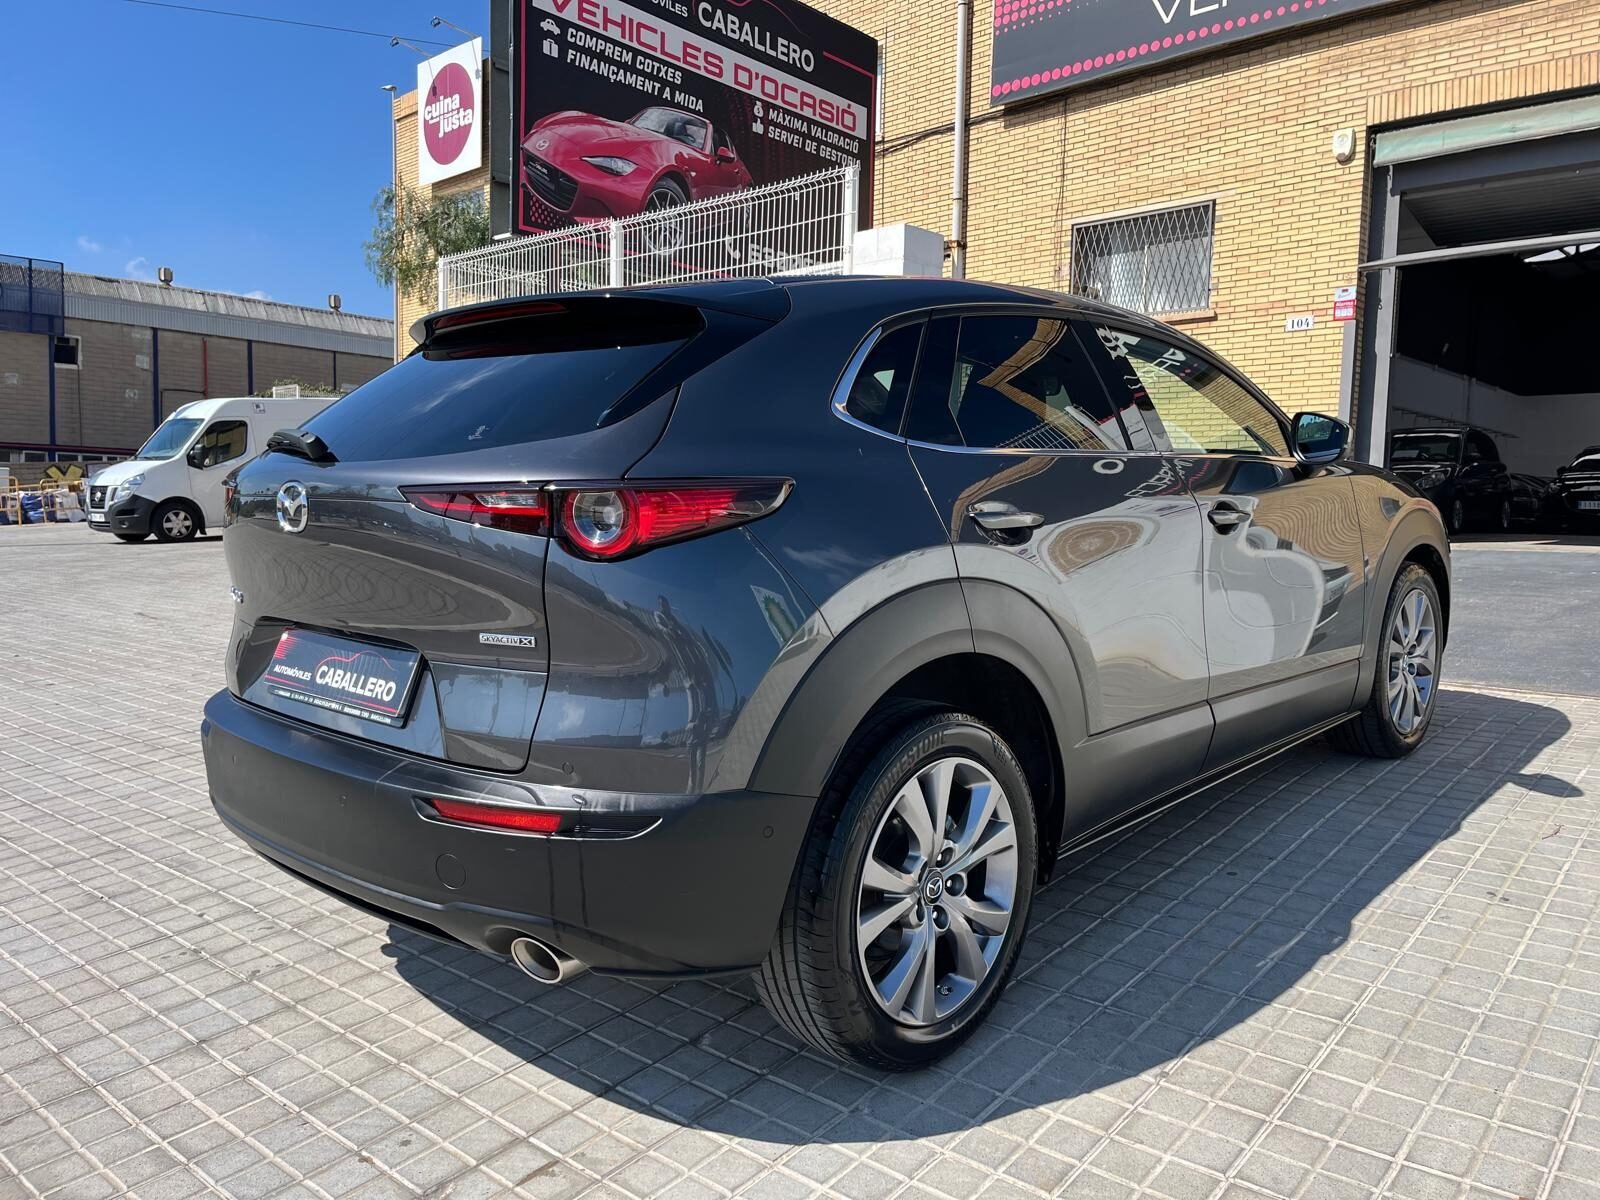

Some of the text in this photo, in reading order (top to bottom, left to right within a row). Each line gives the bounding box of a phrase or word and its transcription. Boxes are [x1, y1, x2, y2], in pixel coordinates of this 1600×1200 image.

[567, 27, 682, 85] COMPREM COTXES
[698, 1, 815, 73] CABALLERO
[552, 0, 857, 133] VEHICLES D'OCASIÓ
[567, 49, 704, 113] FINANÇAMENT A MIDA
[424, 93, 460, 120] cuina
[438, 108, 473, 138] justa
[768, 106, 859, 154] MÀXIMA VALORACIÓ
[768, 126, 802, 149] SERVEI
[805, 139, 817, 155] DE
[1291, 318, 1310, 329] 104
[273, 664, 397, 701] AUTOMÓVILES CABALLERO
